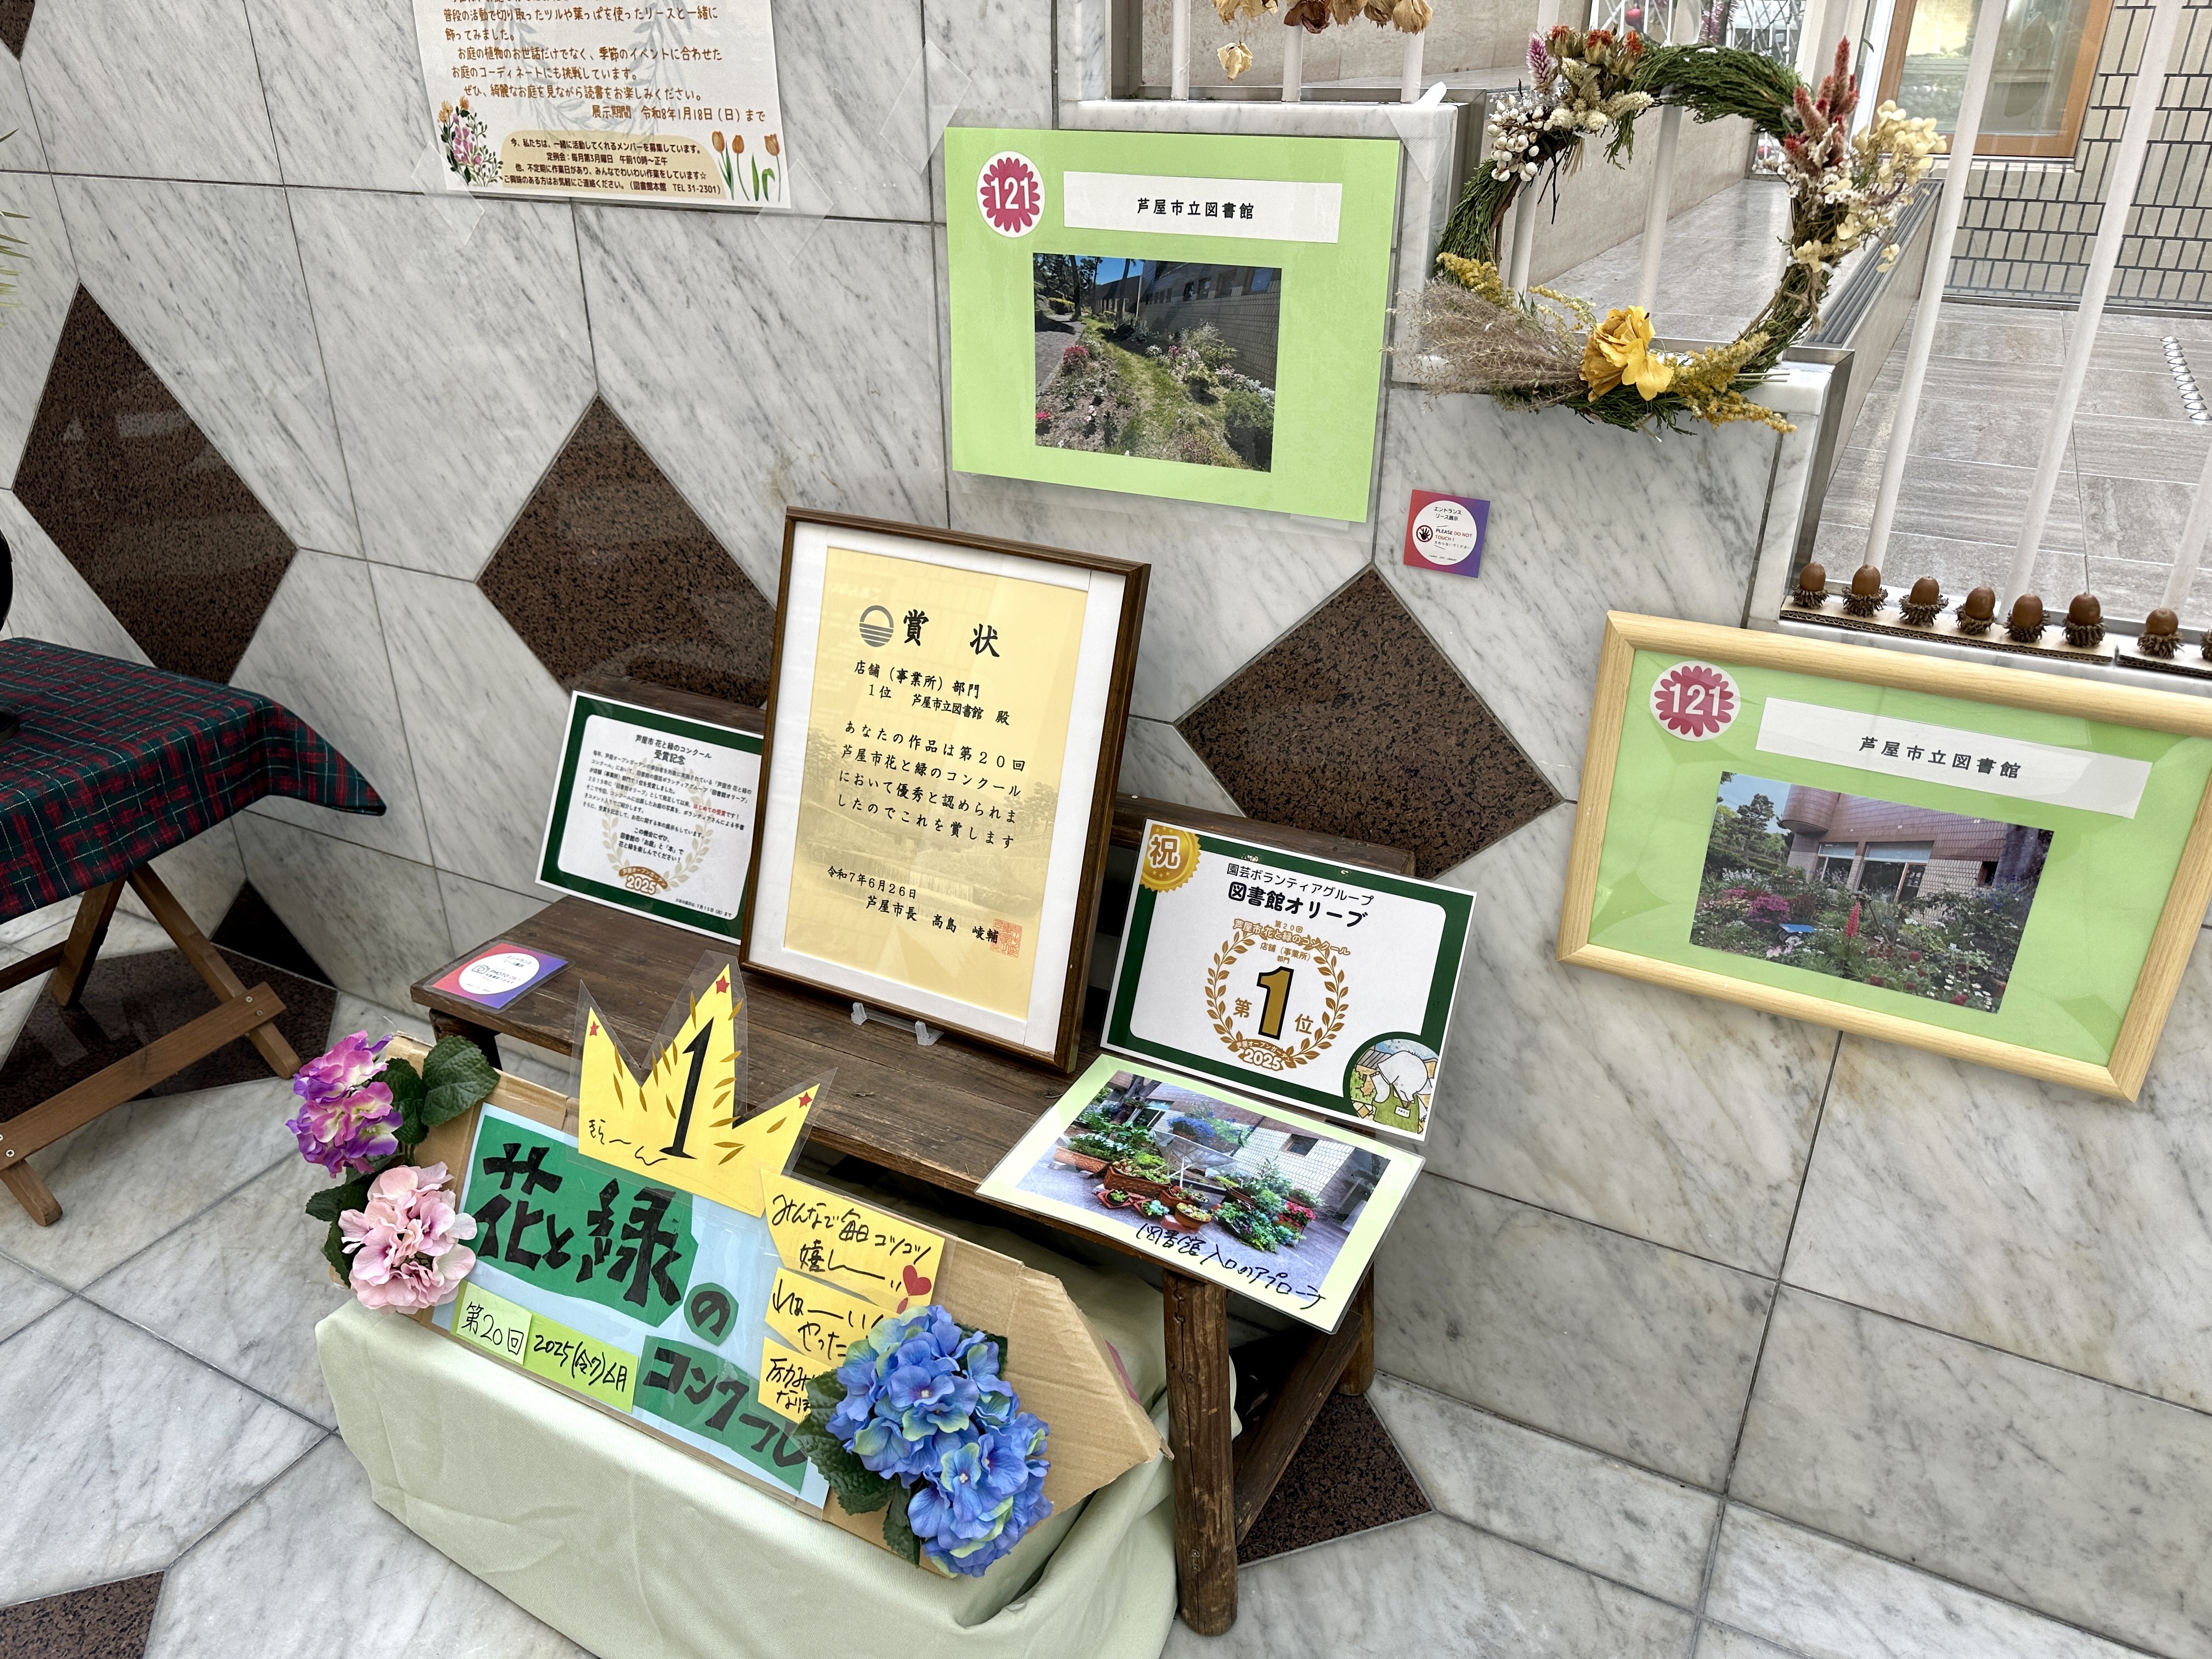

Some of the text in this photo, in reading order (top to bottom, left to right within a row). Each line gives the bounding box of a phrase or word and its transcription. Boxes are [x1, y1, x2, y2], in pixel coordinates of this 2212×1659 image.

[443, 5, 718, 22] 普段の活動で切り取ったツルや葉っぱを使ったリースと一緒に
[445, 27, 515, 41] 飾ってみました。
[457, 46, 723, 61] お庭の植物のお世話だけでなく、季節のイベントに合わせた
[452, 65, 637, 81] お庭のコーディネートにも挑戦しています。
[464, 84, 701, 101] ぜひ、綺麗なお庭を見ながら読書をお楽しみください。
[592, 105, 631, 119] 展示期間
[673, 184, 686, 192] TEL
[990, 177, 1032, 211] 121
[1137, 198, 1254, 219] 芦屋市立図書館
[1434, 506, 1462, 515] エントランス
[854, 659, 980, 699] 店舗（事業所）部門
[911, 693, 984, 721] 芦屋市立図書館
[995, 709, 1011, 726] 殿
[1669, 682, 1722, 718] 121
[653, 749, 686, 765] 受賞記念
[841, 744, 1022, 798] 芦屋市花と緑のコンクール
[1859, 736, 2021, 779] 芦屋市立図書館
[839, 770, 1016, 824] において優秀と認められま
[837, 793, 1014, 849] したのでこれを賞します
[1149, 834, 1181, 869] 祝
[625, 874, 657, 895] 2025
[827, 865, 917, 900] 令和7年6月26日
[1226, 863, 1374, 906] 園芸ボランティアグループ
[866, 895, 917, 922] 芦屋市長
[1228, 882, 1369, 928] 図書館オリーブ
[489, 969, 510, 978] PHOTO
[1277, 955, 1290, 964] 部門
[1233, 966, 1313, 1041] 第 1 位
[1243, 1048, 1282, 1071] 2025
[658, 1016, 714, 1160] 1
[461, 1301, 524, 1356] 第20回
[643, 1346, 809, 1468] コンクール
